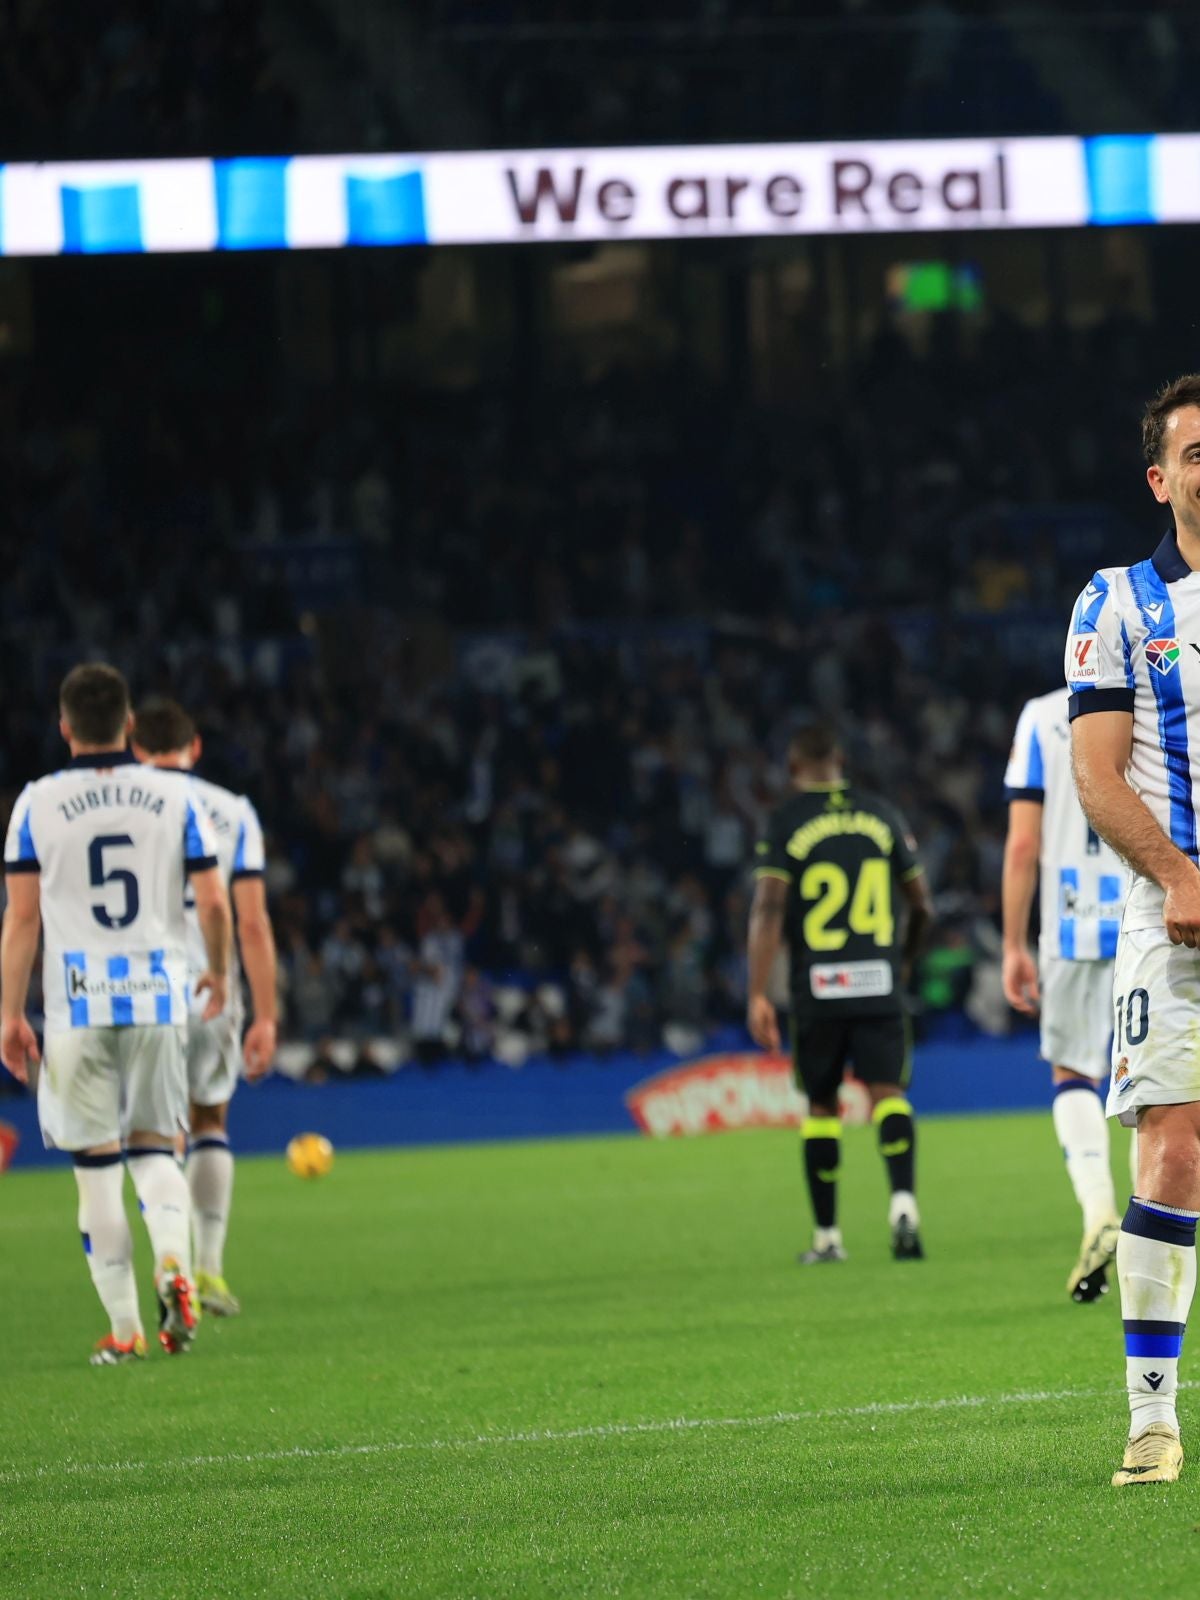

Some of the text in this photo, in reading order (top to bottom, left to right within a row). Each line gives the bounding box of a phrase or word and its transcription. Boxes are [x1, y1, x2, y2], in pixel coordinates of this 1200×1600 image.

[506, 154, 1008, 223] We are Real
[57, 786, 165, 822] ZUBELDIA
[88, 834, 140, 929] 5
[800, 857, 895, 951] 24
[1115, 987, 1150, 1053] 10
